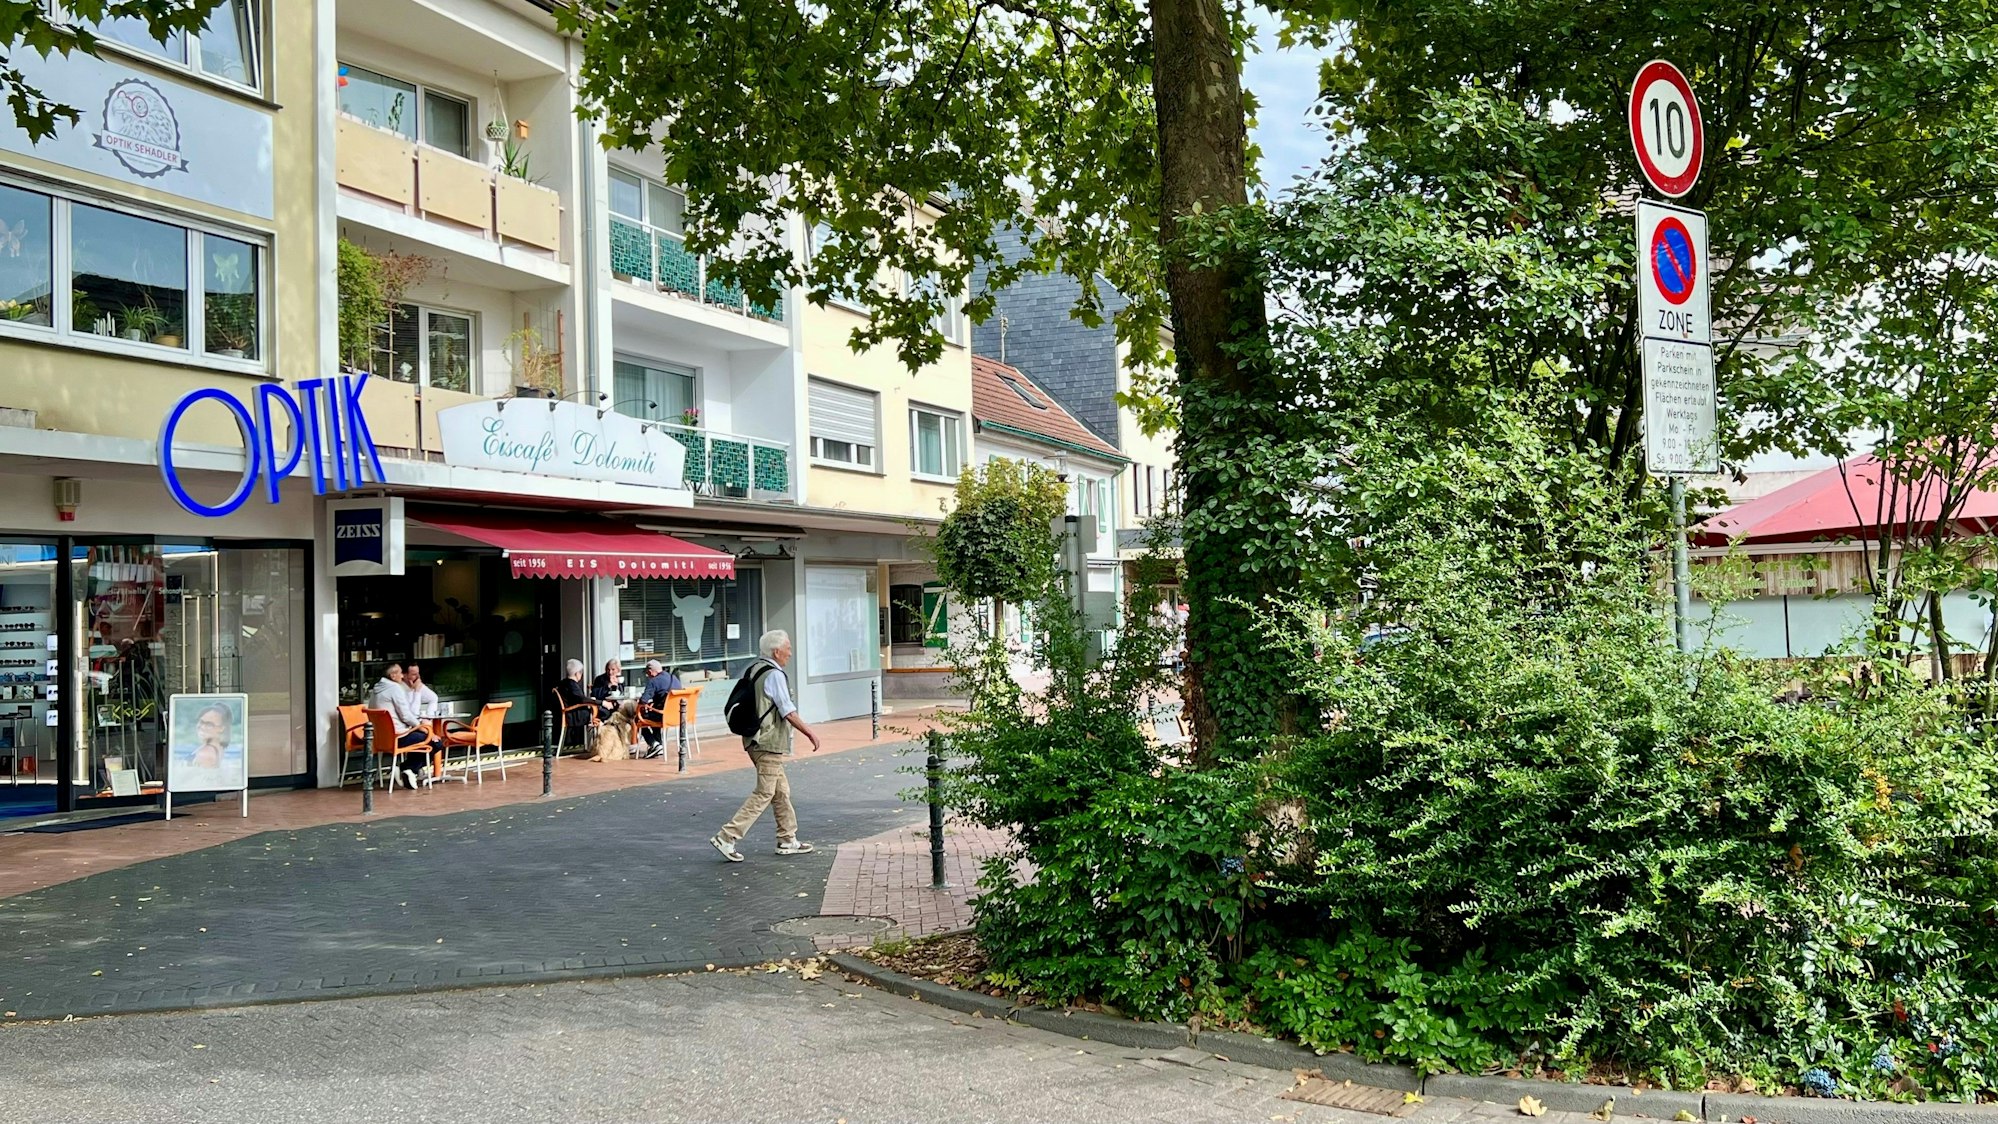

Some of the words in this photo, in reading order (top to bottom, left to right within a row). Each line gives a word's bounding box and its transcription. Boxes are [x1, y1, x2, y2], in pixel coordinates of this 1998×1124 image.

[1649, 98, 1685, 159] 10
[106, 135, 132, 150] OPTIK
[134, 143, 177, 163] SEHADLER
[1659, 309, 1693, 334] ZONE
[1660, 346, 1684, 360] Parken
[1685, 352, 1697, 361] mit
[1657, 361, 1694, 376] Parkschein
[1695, 366, 1702, 376] in
[1650, 378, 1710, 392] gekennzeichneten
[1655, 391, 1681, 404] Flächen
[1684, 396, 1707, 406] erlaubt
[1666, 407, 1698, 423] Werktags
[157, 373, 387, 518] OPTIK
[482, 416, 555, 471] Eiscafé
[571, 429, 657, 474] Dolomiti
[337, 523, 381, 539] ZEISS
[513, 558, 526, 568] seit
[528, 558, 546, 568] 1956
[567, 559, 597, 568] EIS
[618, 560, 694, 570] Dolomiti
[708, 562, 717, 570] seit
[718, 562, 732, 570] 1956
